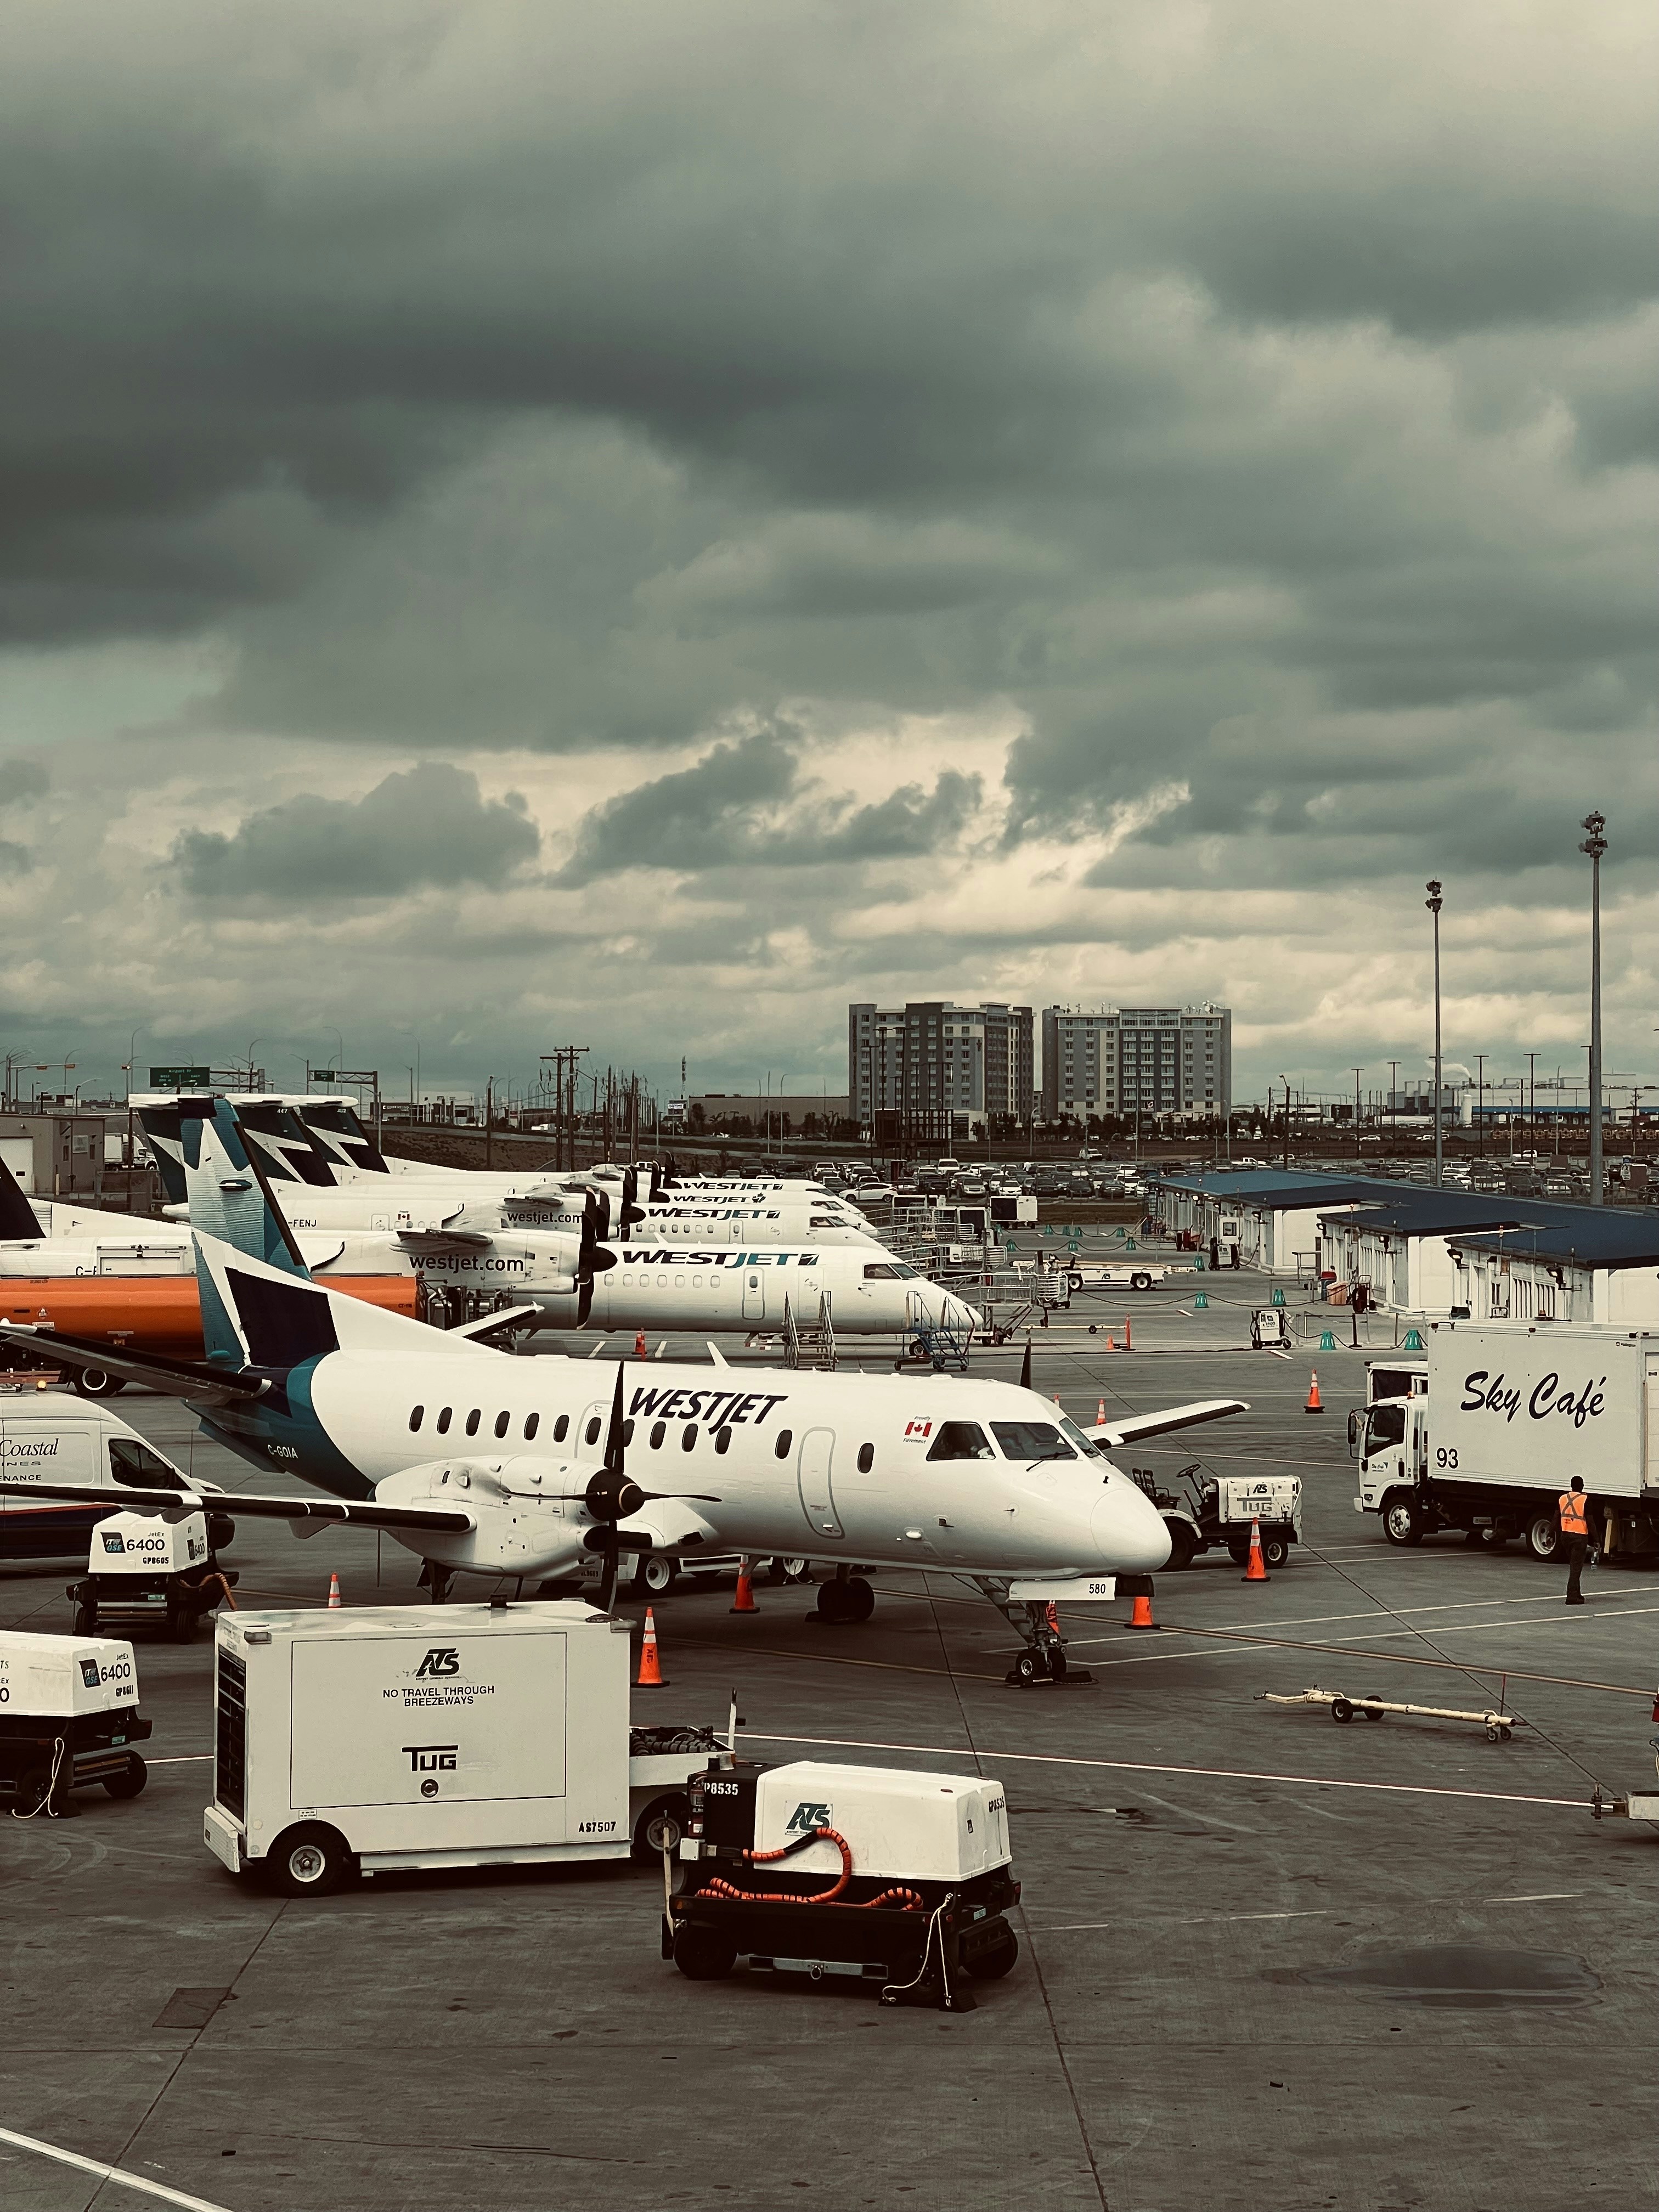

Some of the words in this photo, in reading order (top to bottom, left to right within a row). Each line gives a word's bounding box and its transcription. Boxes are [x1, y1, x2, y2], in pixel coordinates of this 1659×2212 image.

[684, 1182, 772, 1190] WESTJET
[674, 1195, 750, 1204] WESTJET
[507, 1211, 583, 1225] westjet.com
[648, 1207, 767, 1221] WESTJET
[409, 1254, 523, 1274] westjet.com
[623, 1249, 799, 1268] WESTJET
[1460, 1370, 1522, 1423] Sky
[1528, 1372, 1607, 1429] Café
[629, 1387, 789, 1435] WESTJET
[0, 1438, 59, 1457] Coastal
[268, 1444, 298, 1459] C-GOIA
[1436, 1447, 1459, 1469] 93
[126, 1539, 165, 1551] 6400
[1089, 1583, 1106, 1594] 580
[416, 1647, 460, 1677] ATS
[101, 1662, 131, 1682] 6400
[383, 1689, 398, 1698] NO
[401, 1688, 441, 1697] TRAVEL
[443, 1685, 494, 1696] THROUGH
[404, 1696, 474, 1707] BREEZEWAYS
[402, 1745, 459, 1771] TUG
[786, 1802, 831, 1831] ATS
[578, 1821, 616, 1832] AS7507
